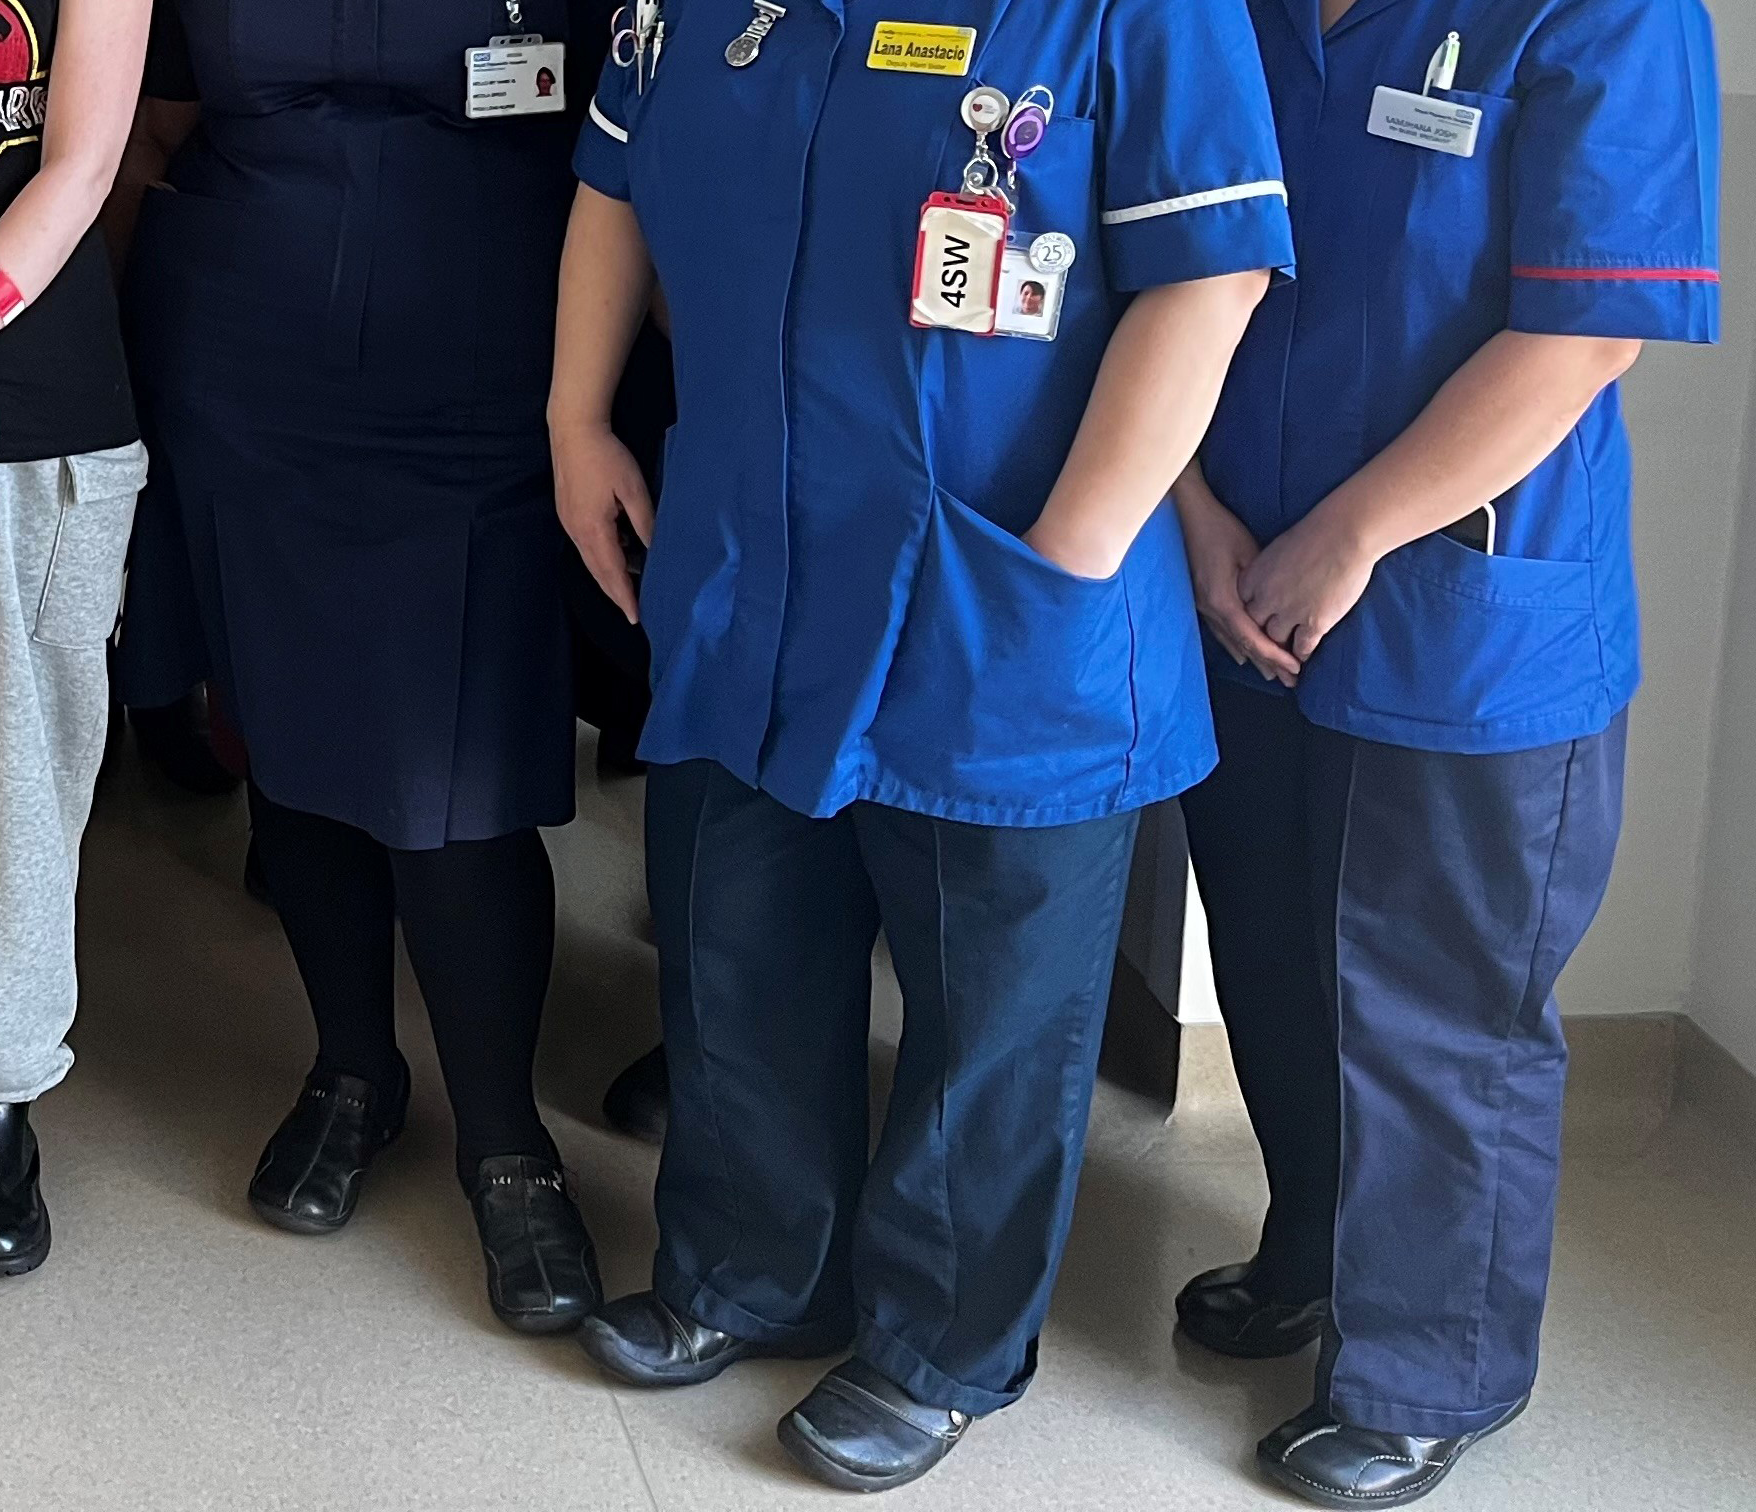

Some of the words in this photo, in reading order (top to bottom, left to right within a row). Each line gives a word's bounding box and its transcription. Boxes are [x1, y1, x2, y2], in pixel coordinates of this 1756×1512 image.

[874, 39, 902, 56] Lana
[904, 41, 965, 61] Anastacio
[1042, 244, 1063, 262] 25
[940, 234, 971, 309] 4SW
